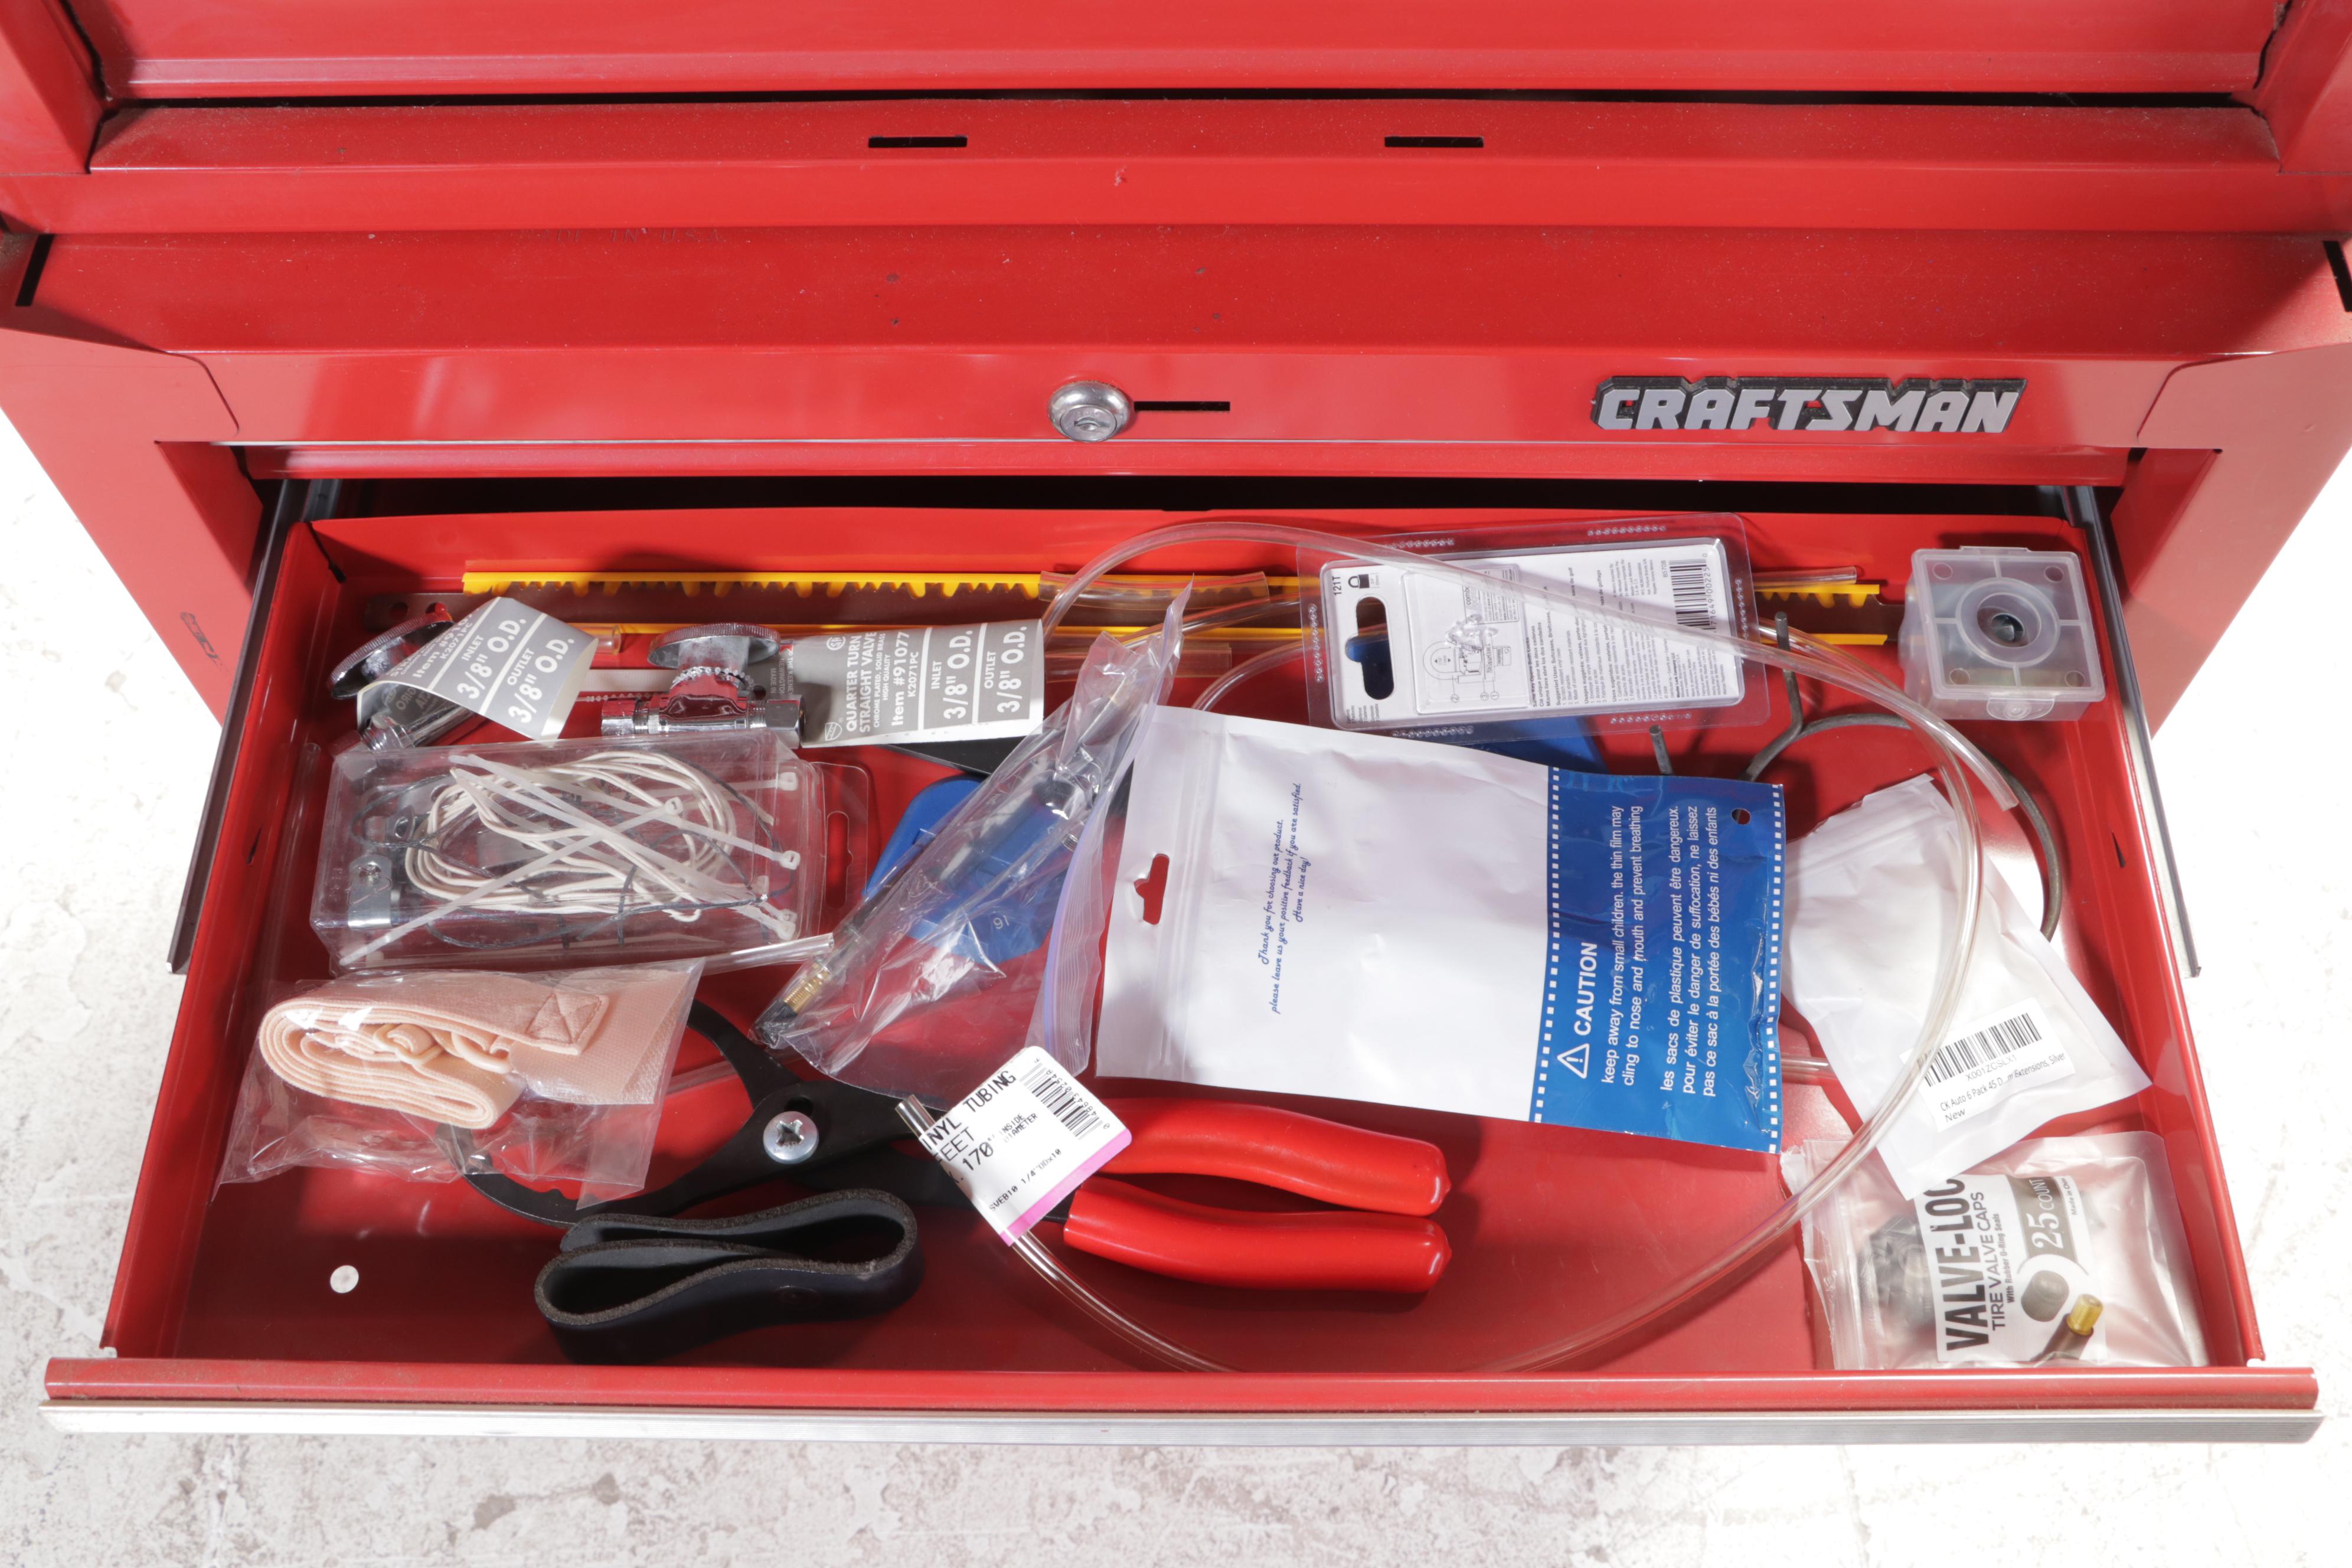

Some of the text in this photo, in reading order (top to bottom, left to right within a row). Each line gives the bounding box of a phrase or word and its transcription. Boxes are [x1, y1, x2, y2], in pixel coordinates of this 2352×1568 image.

[1596, 387, 2020, 433] CRAFTSMAN
[1330, 574, 1343, 596] 121T
[1660, 559, 1668, 578] 85708
[1703, 566, 1713, 594] 00225
[1706, 597, 1717, 625] 71649
[413, 651, 440, 678] Item
[439, 613, 473, 648] #910
[440, 621, 473, 660] K2071PC
[457, 618, 527, 700] 3/8" O.D.
[461, 634, 485, 661] INLET
[874, 652, 883, 670] SOLID
[877, 632, 886, 650] BRASS
[1548, 638, 1556, 664] Suitcases,
[507, 648, 534, 685] OUTLET
[508, 638, 574, 724] 3/8" O.D.
[845, 635, 862, 731] QUARTER TURN
[859, 632, 877, 732] STRAIGHT VALVE
[874, 671, 882, 697] PLATED,
[881, 654, 891, 700] HIGH QUALITY
[891, 631, 910, 726] Item #91077
[907, 651, 919, 697] K2071PC
[930, 660, 942, 689] INLET
[942, 629, 973, 719] 3/8" O.D.
[984, 651, 996, 689] OUTLET
[996, 625, 1027, 713] 3/8" O.D.
[1553, 679, 1562, 705] Suggested
[1296, 873, 1305, 889] nice
[1298, 855, 1311, 873] day!
[1257, 818, 1283, 965] Thank you for choosing our product.
[1268, 782, 1303, 1014] please leave us your positive feedback if you are satisfied.
[1292, 897, 1304, 922] Have
[1601, 805, 1625, 1083] keep away from small children. the thin film may
[1622, 805, 1645, 1086] cling to nose and mouth and prevent breathing
[1660, 805, 1685, 1090] les sacs de plastique peuvent être dangereux.
[1681, 805, 1704, 1094] pour éviter le danger de suffocation, ne laissez
[1702, 806, 1721, 1097] pas ce sac à la portée des bébés ni des enfants
[1573, 942, 1598, 1036] CAUTION
[1939, 1100, 1949, 1112] CK
[1950, 1093, 1966, 1108] Auto
[1966, 1091, 1972, 1100] 6
[1972, 1084, 1988, 1097] Pack
[1987, 1080, 1997, 1090] 45
[2014, 1059, 2050, 1079] Extensions,
[2049, 1052, 2066, 1065] Silver
[1965, 1054, 2018, 1081] X001ZCSLX1
[922, 1070, 1017, 1151] INYL TUBING
[1073, 1092, 1097, 1117] 48643
[1945, 1108, 1966, 1123] New
[988, 1185, 1019, 1211] SVEB10
[2026, 1178, 2064, 1249] 25 COUNT
[2069, 1196, 2077, 1215] Made
[1922, 1178, 1989, 1351] VALVE-LOC
[1969, 1191, 2005, 1331] TIRE VALVE CAPS
[1992, 1213, 2015, 1303] With Rubber O-Ring Seals
